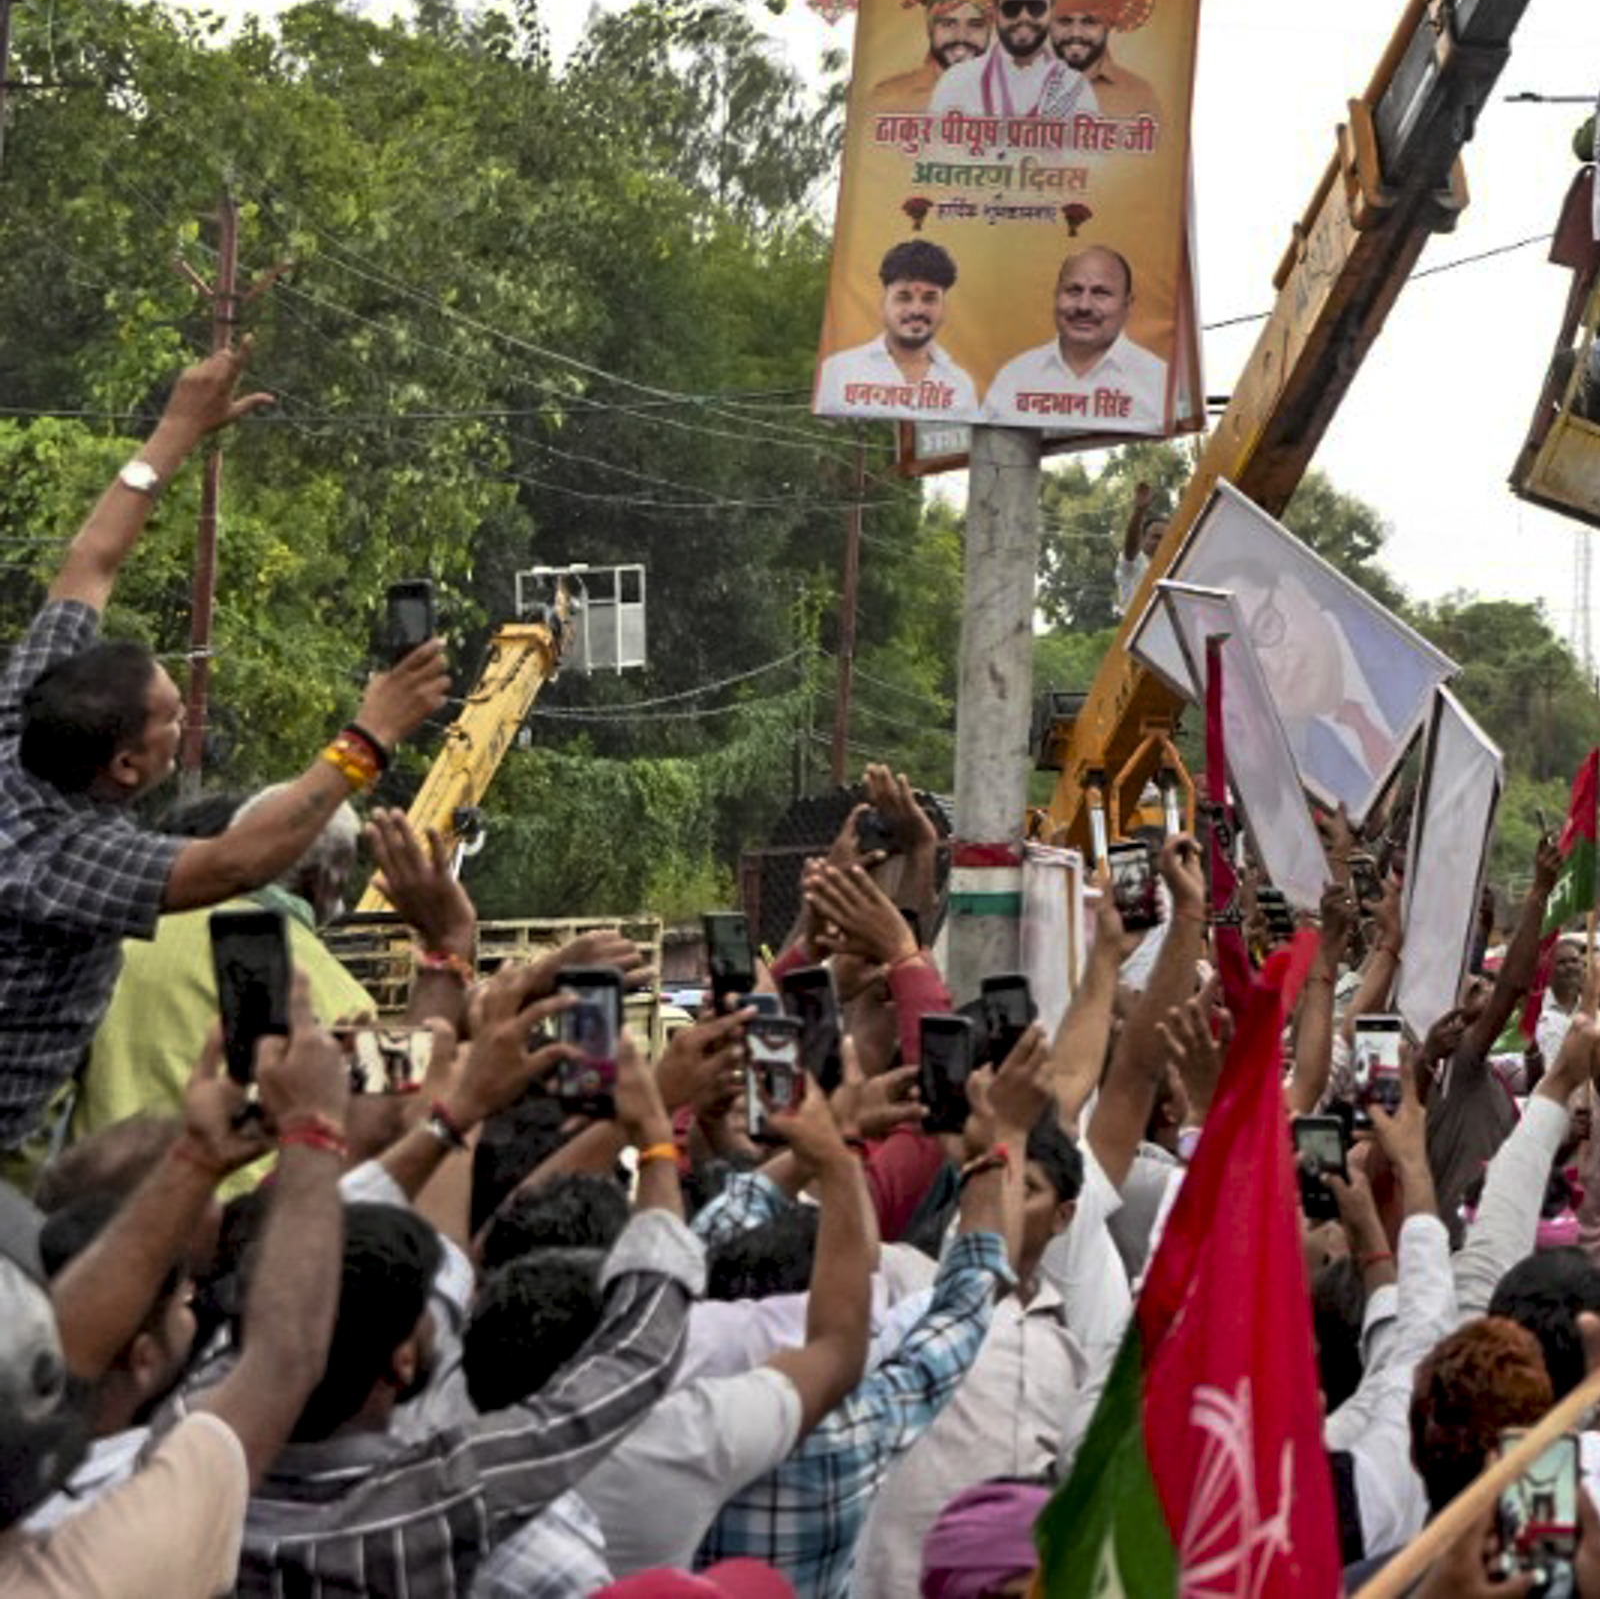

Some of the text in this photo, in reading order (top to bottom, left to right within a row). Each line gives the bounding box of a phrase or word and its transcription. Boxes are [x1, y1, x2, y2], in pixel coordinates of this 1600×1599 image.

[874, 115, 934, 153] ठाकुर
[941, 111, 999, 156] पीयूष
[1006, 117, 1066, 149] प्रताप
[1123, 113, 1157, 152] जी
[911, 155, 1090, 191] अवतरण दिवस
